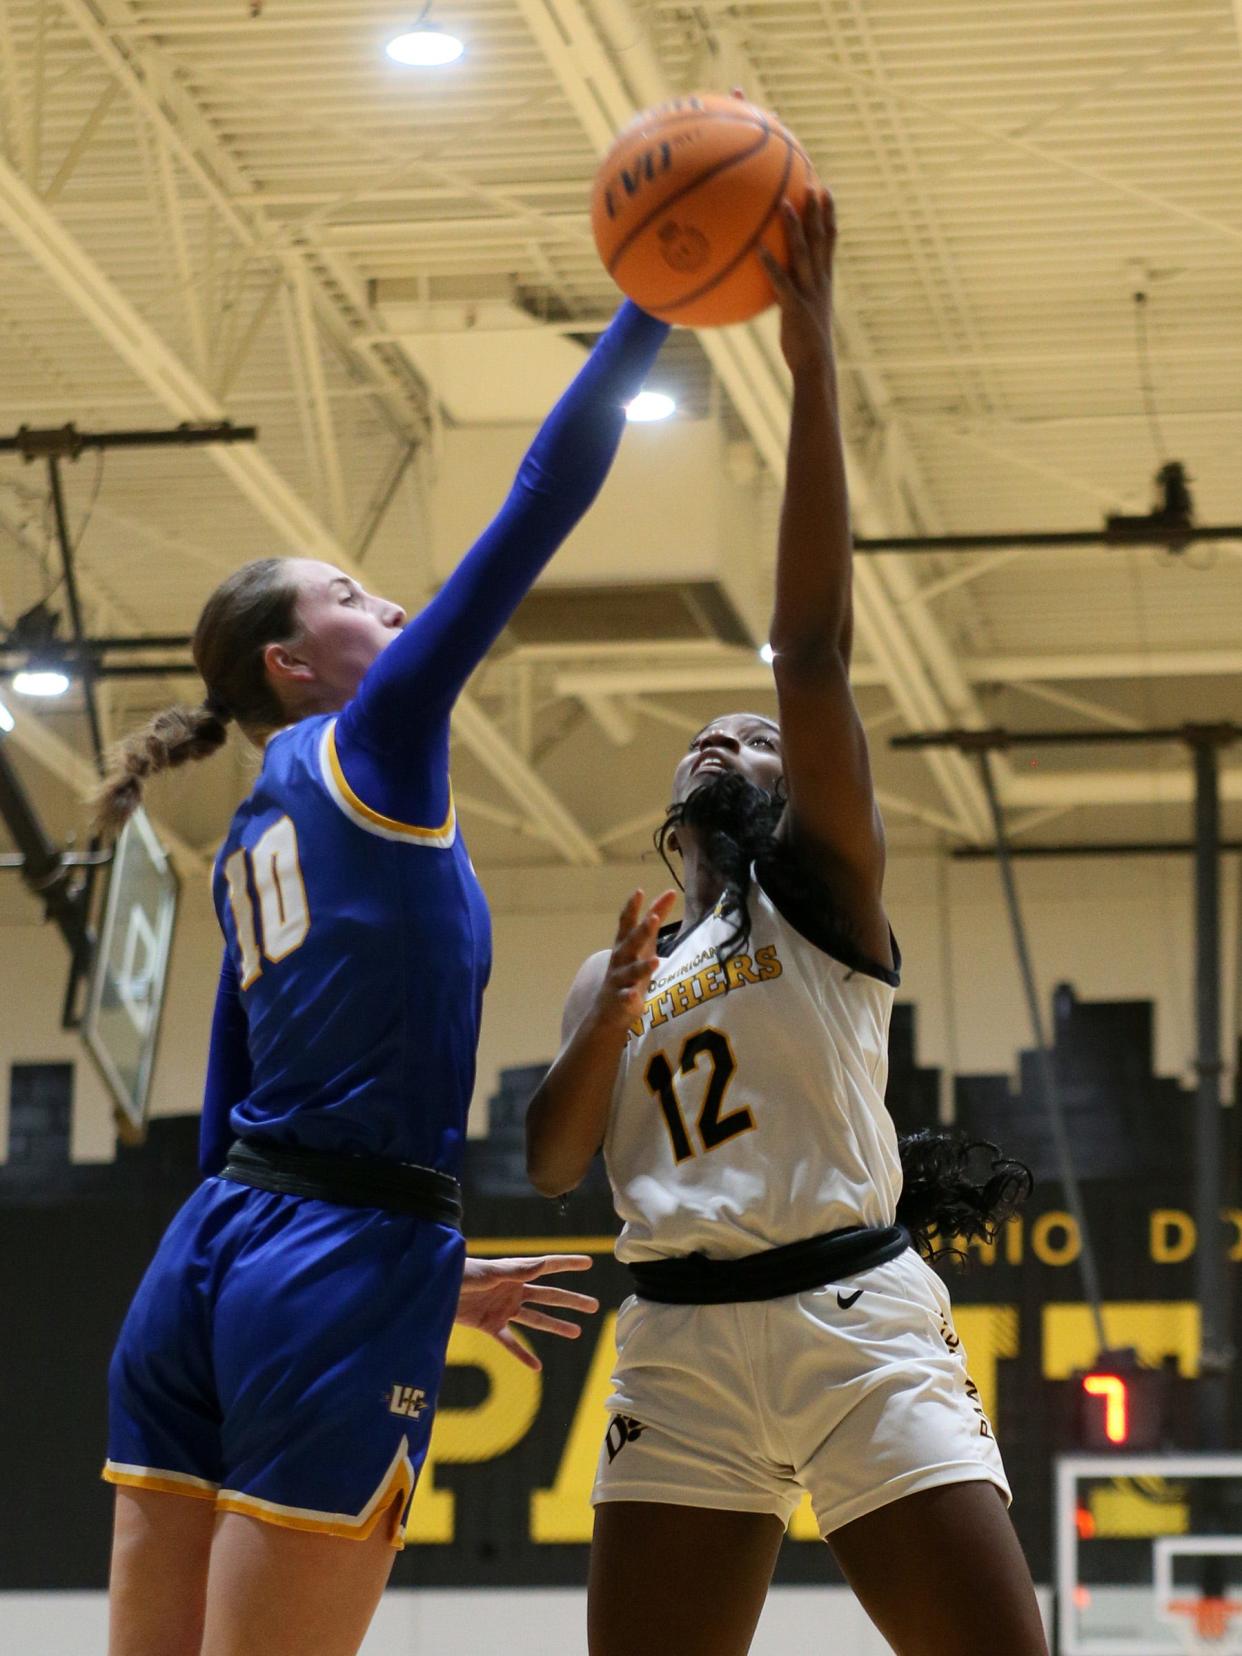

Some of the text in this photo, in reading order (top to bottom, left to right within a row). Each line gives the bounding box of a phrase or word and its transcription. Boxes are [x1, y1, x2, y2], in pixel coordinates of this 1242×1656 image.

[223, 814, 311, 991] 10
[645, 1025, 757, 1166] 12
[1083, 1374, 1126, 1443] 7
